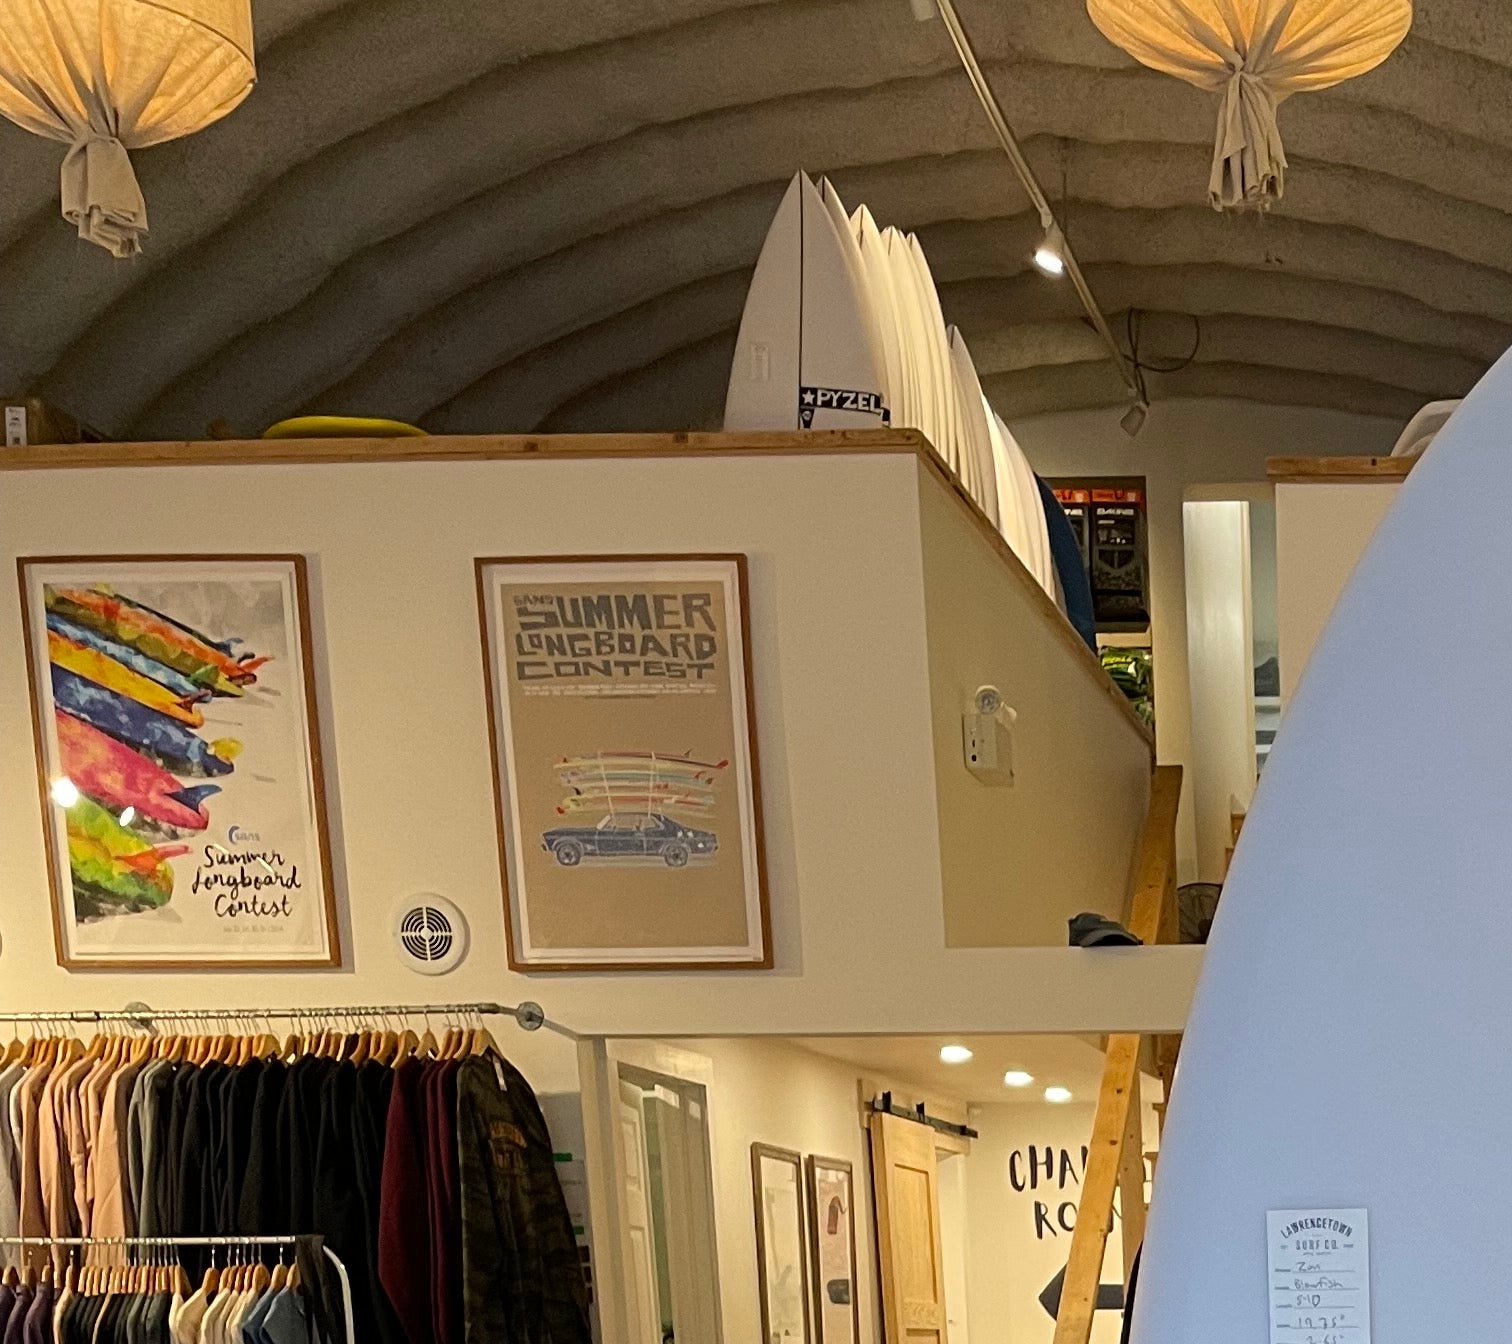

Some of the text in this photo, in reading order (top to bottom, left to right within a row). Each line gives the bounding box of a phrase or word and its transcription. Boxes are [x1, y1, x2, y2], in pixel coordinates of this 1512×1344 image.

[816, 389, 883, 414] PYZEL
[517, 593, 717, 632] SUMMER
[515, 631, 717, 660] LONGBOARD
[517, 660, 715, 681] CONTEST
[204, 845, 285, 868] Summer
[214, 894, 293, 917] Contest
[1280, 1218, 1353, 1238] LAWRENCETOWN
[1296, 1240, 1320, 1250] SURF
